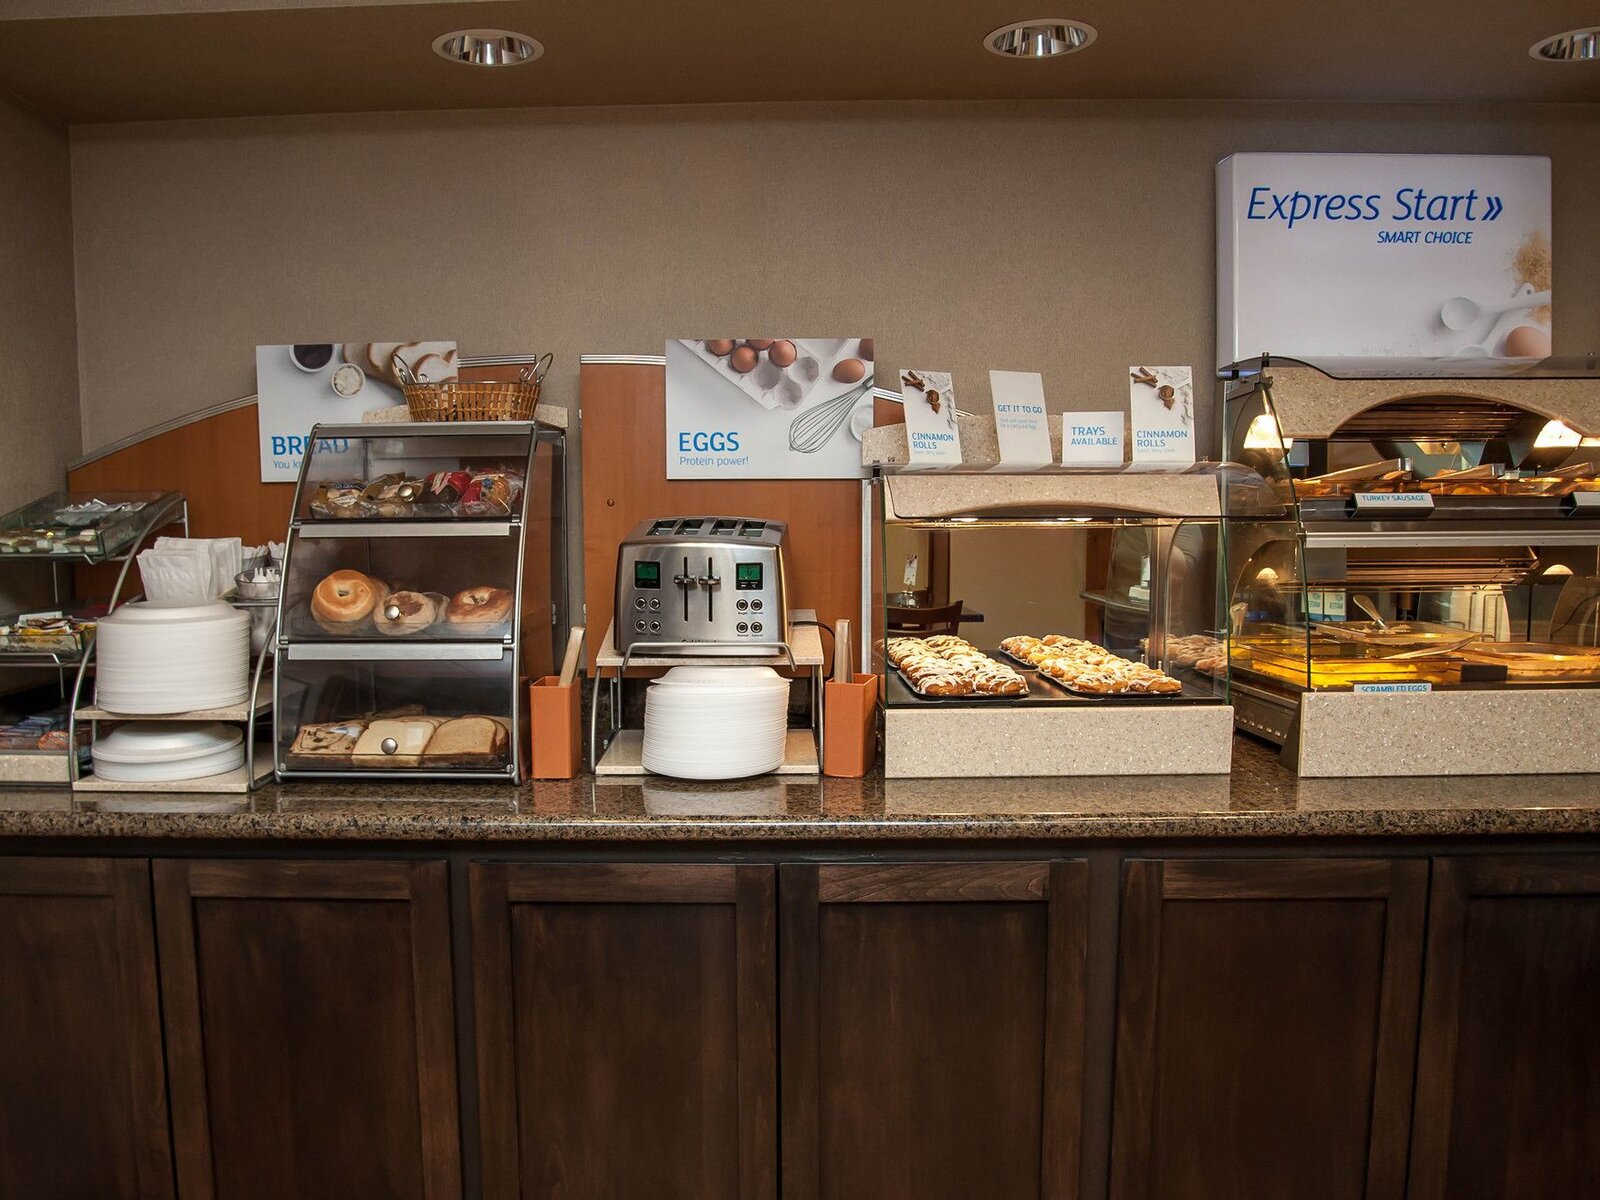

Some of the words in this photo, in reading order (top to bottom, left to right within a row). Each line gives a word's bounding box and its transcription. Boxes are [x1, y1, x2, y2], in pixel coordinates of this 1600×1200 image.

[1247, 186, 1381, 229] Express
[1377, 231, 1421, 244] SMART
[1424, 231, 1473, 244] CHOICE
[1071, 426, 1105, 436] TRAYS
[1136, 430, 1188, 439] CINNAMON
[679, 431, 740, 452] EGGS
[911, 432, 954, 442] CINNAMON
[1071, 437, 1118, 445] AVAILABLE
[912, 441, 938, 450] ROLLS
[1136, 439, 1166, 447] ROLLS
[273, 460, 290, 469] You
[679, 456, 714, 466] Protein
[717, 456, 749, 467] power!
[1362, 494, 1390, 502] TURKEY
[1391, 494, 1426, 502] SAUSAGE
[1361, 685, 1406, 693] SCRAMBLED
[1408, 684, 1428, 693] EGGS
